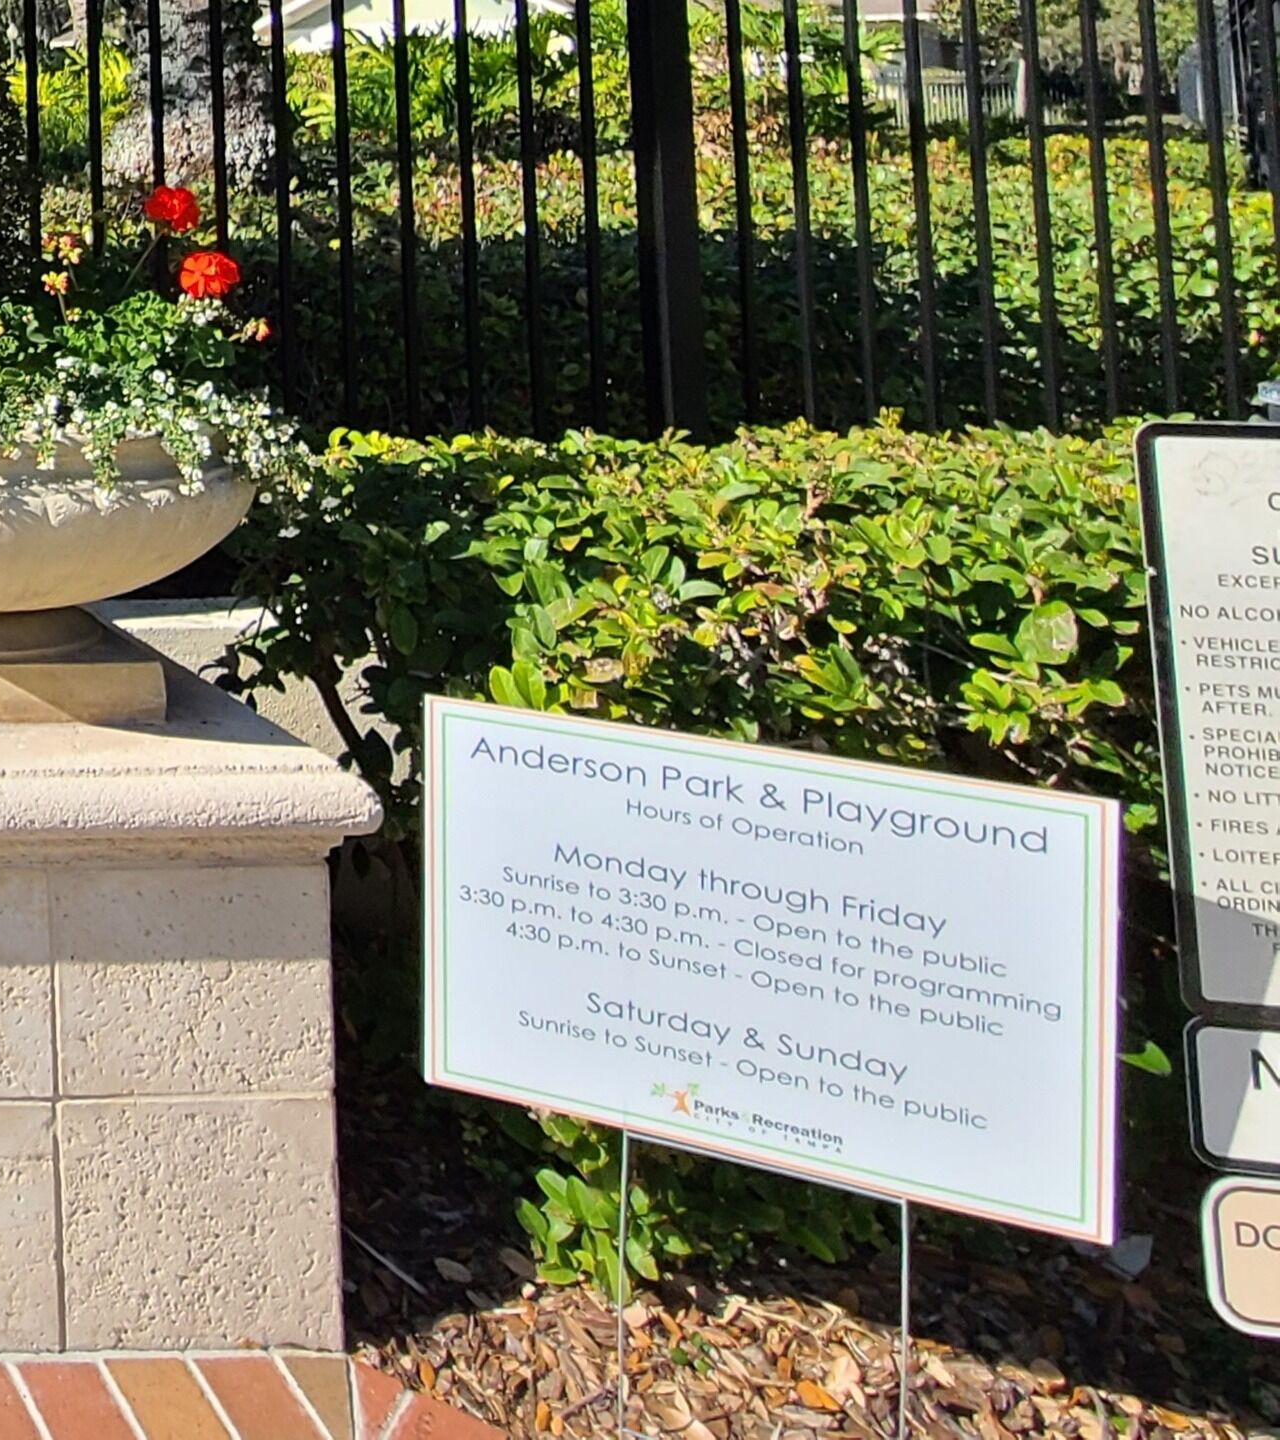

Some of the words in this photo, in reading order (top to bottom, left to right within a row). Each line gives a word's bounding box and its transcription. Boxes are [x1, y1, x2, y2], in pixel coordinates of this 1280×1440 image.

[1180, 604, 1210, 620] NO
[1217, 606, 1280, 623] ALCO
[1199, 682, 1251, 699] PETS
[1202, 727, 1280, 745] SPECIA
[470, 737, 646, 788] Anderson
[661, 765, 744, 804] Park
[759, 783, 787, 810] &
[802, 787, 1048, 854] Playground
[1208, 789, 1236, 804] NO
[626, 798, 692, 825] Hours
[699, 813, 722, 831] of
[731, 816, 864, 855] Operation
[1210, 818, 1269, 835] FIRES
[553, 842, 687, 891] Monday
[700, 867, 829, 914] through
[842, 894, 947, 939] Friday
[1216, 878, 1253, 893] ALL
[502, 865, 580, 895] Sunrise
[589, 882, 611, 901] to
[618, 888, 666, 912] 3:30
[674, 901, 728, 924] p.m.
[753, 914, 826, 943] Open
[836, 929, 861, 950] to
[871, 935, 913, 960] the
[923, 948, 1007, 978] public
[458, 884, 505, 907] 3:30
[511, 897, 562, 920] p.m.
[571, 905, 593, 925] to
[601, 913, 648, 936] 4:30
[656, 925, 710, 949] p.m.
[734, 938, 823, 971] Closed
[832, 956, 865, 980] for
[874, 969, 1062, 1022] programming
[505, 921, 551, 944] 4:30
[558, 934, 609, 956] p.m.
[619, 942, 641, 962] to
[649, 948, 726, 979] Sunset
[751, 970, 824, 1000] Open
[834, 986, 859, 1007] to
[869, 993, 910, 1017] the
[920, 1007, 1004, 1037] public
[586, 992, 731, 1046] Saturday
[743, 1027, 766, 1051] &
[777, 1033, 908, 1085] Sunday
[518, 1009, 596, 1041] Sunrise
[605, 1028, 627, 1048] to
[634, 1035, 712, 1067] Sunset
[736, 1059, 809, 1090] Open
[819, 1077, 844, 1098] to
[853, 1084, 895, 1109] the
[904, 1099, 989, 1130] public
[693, 1099, 740, 1121] Parks
[752, 1113, 844, 1146] Recreation
